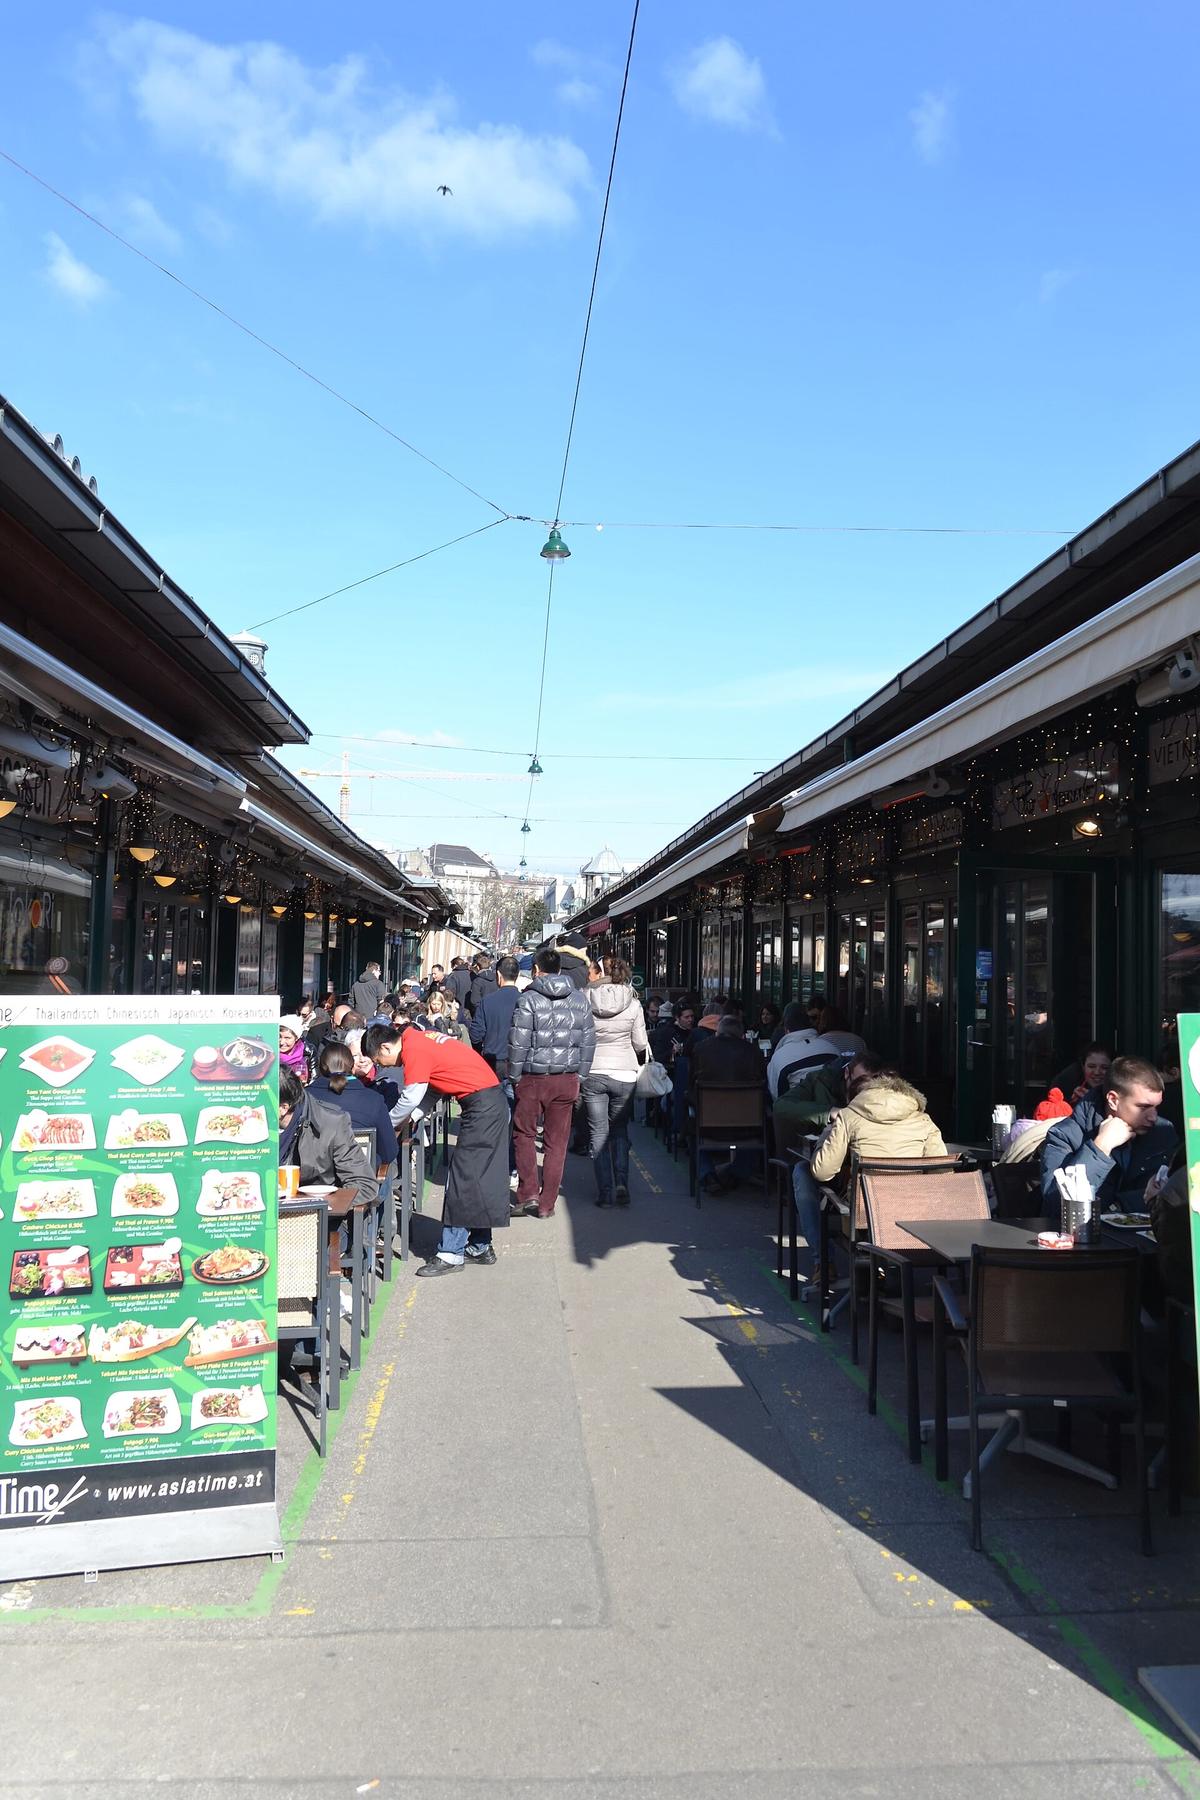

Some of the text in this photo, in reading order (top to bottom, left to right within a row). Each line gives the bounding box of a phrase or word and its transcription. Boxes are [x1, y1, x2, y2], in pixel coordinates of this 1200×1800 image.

[107, 1008, 160, 1019] Chinesisch
[0, 1470, 264, 1515] Time www.asiatime.at
